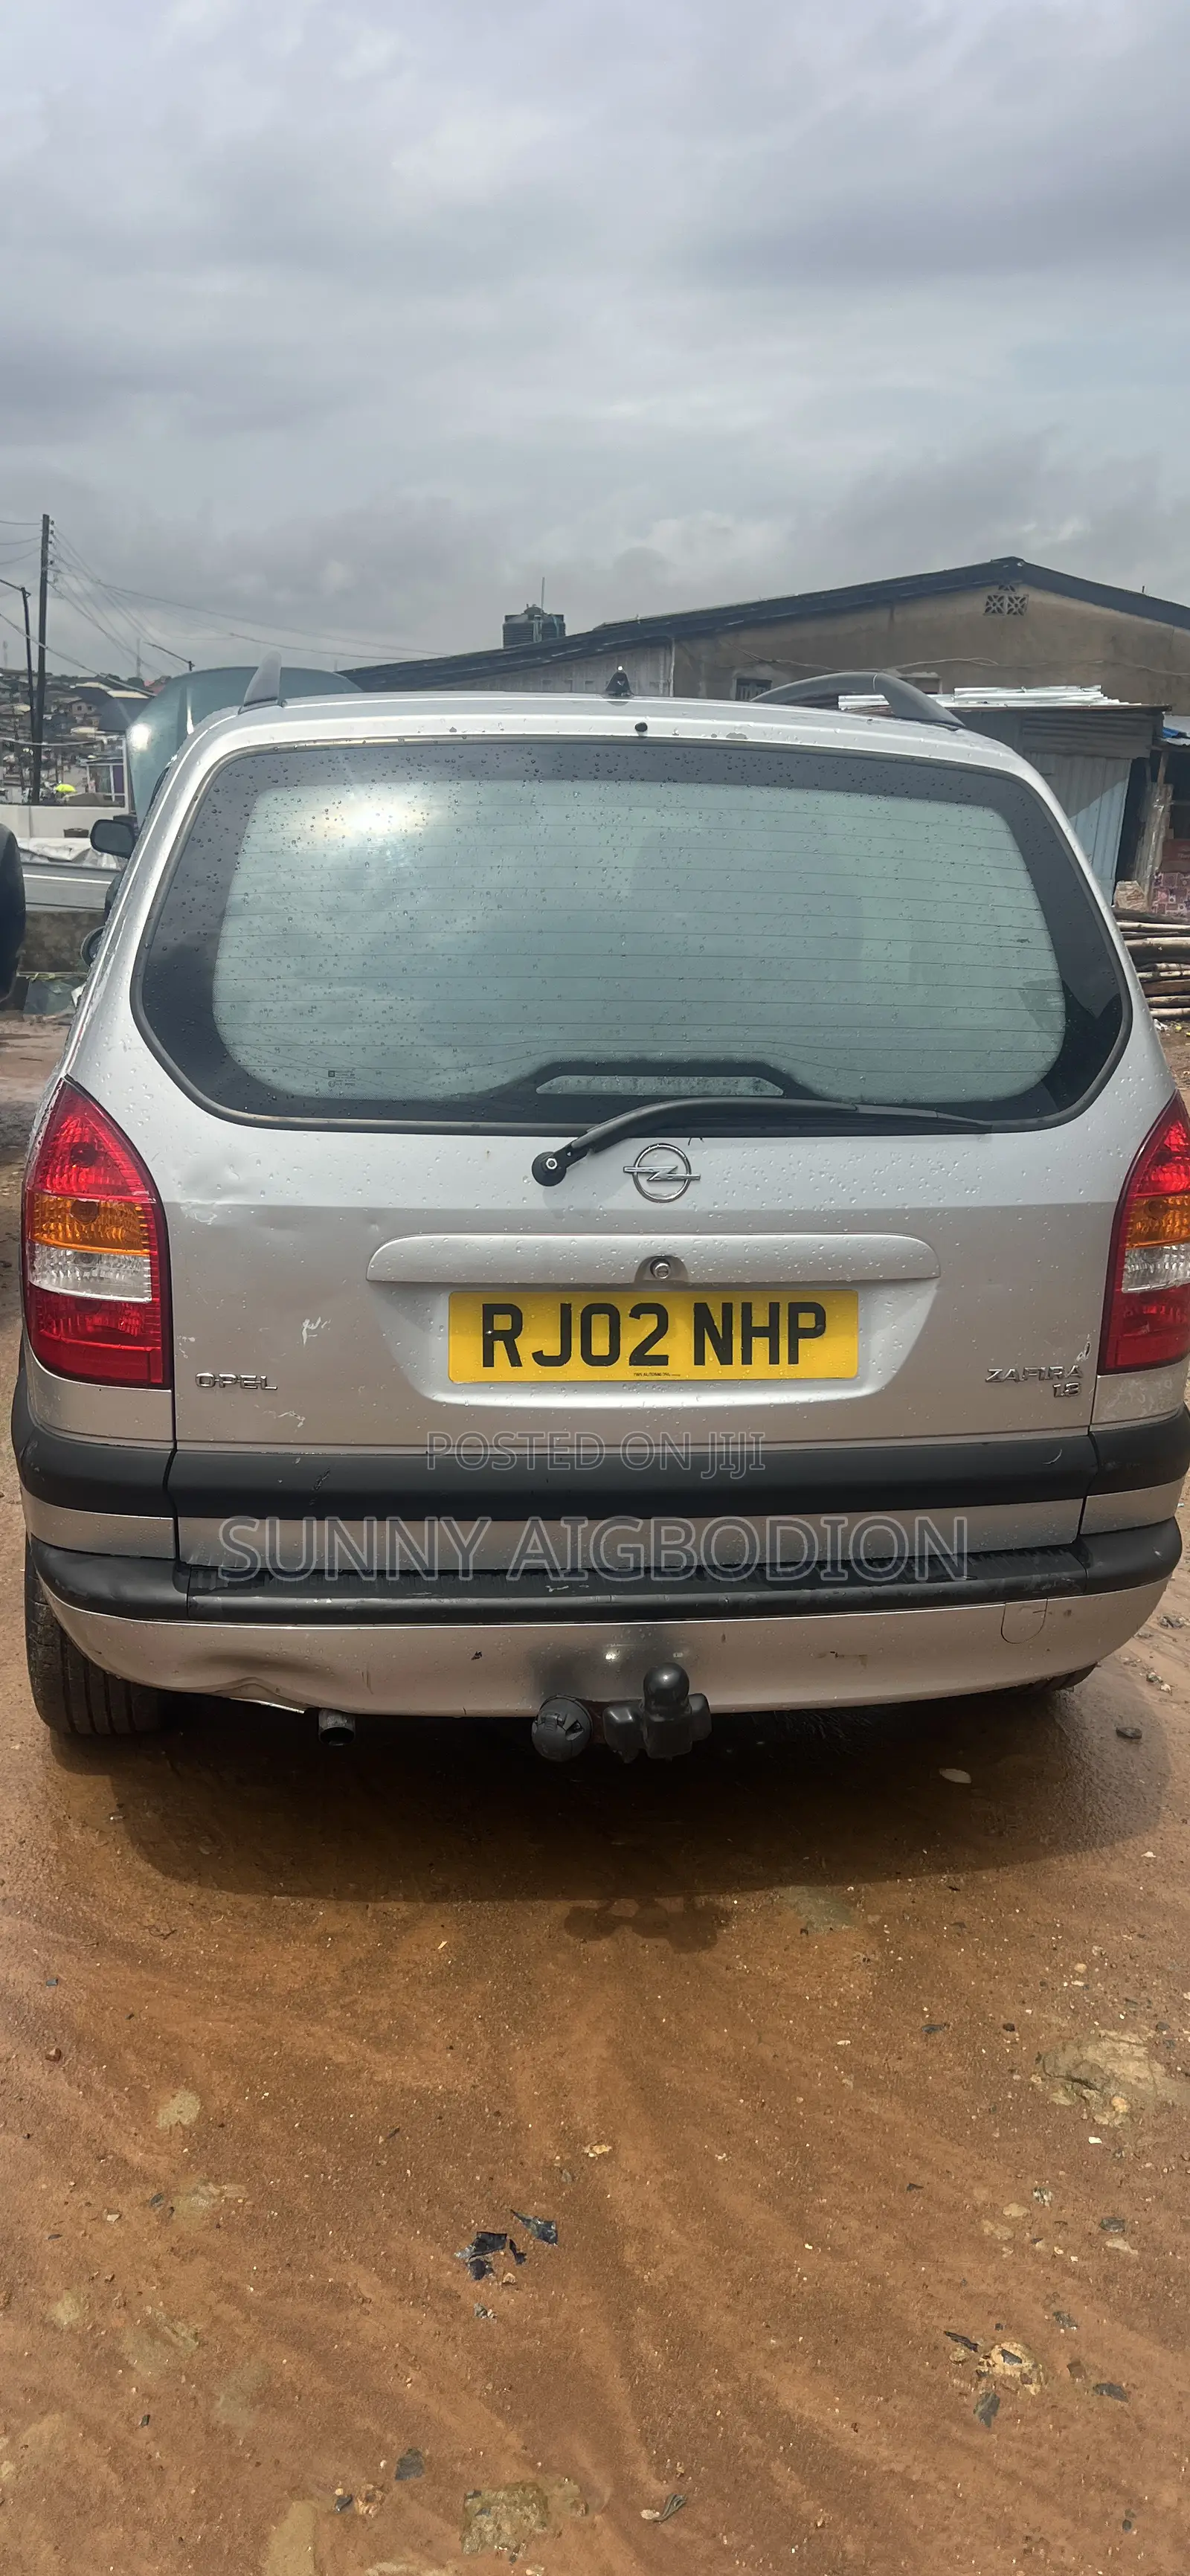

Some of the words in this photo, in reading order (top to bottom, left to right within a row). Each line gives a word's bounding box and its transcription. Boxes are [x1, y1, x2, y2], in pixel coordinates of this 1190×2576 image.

[482, 1303, 669, 1367] RJ02
[693, 1302, 827, 1366] NHP
[195, 1372, 278, 1390] OPEL
[985, 1365, 1084, 1383] ZAFIRA
